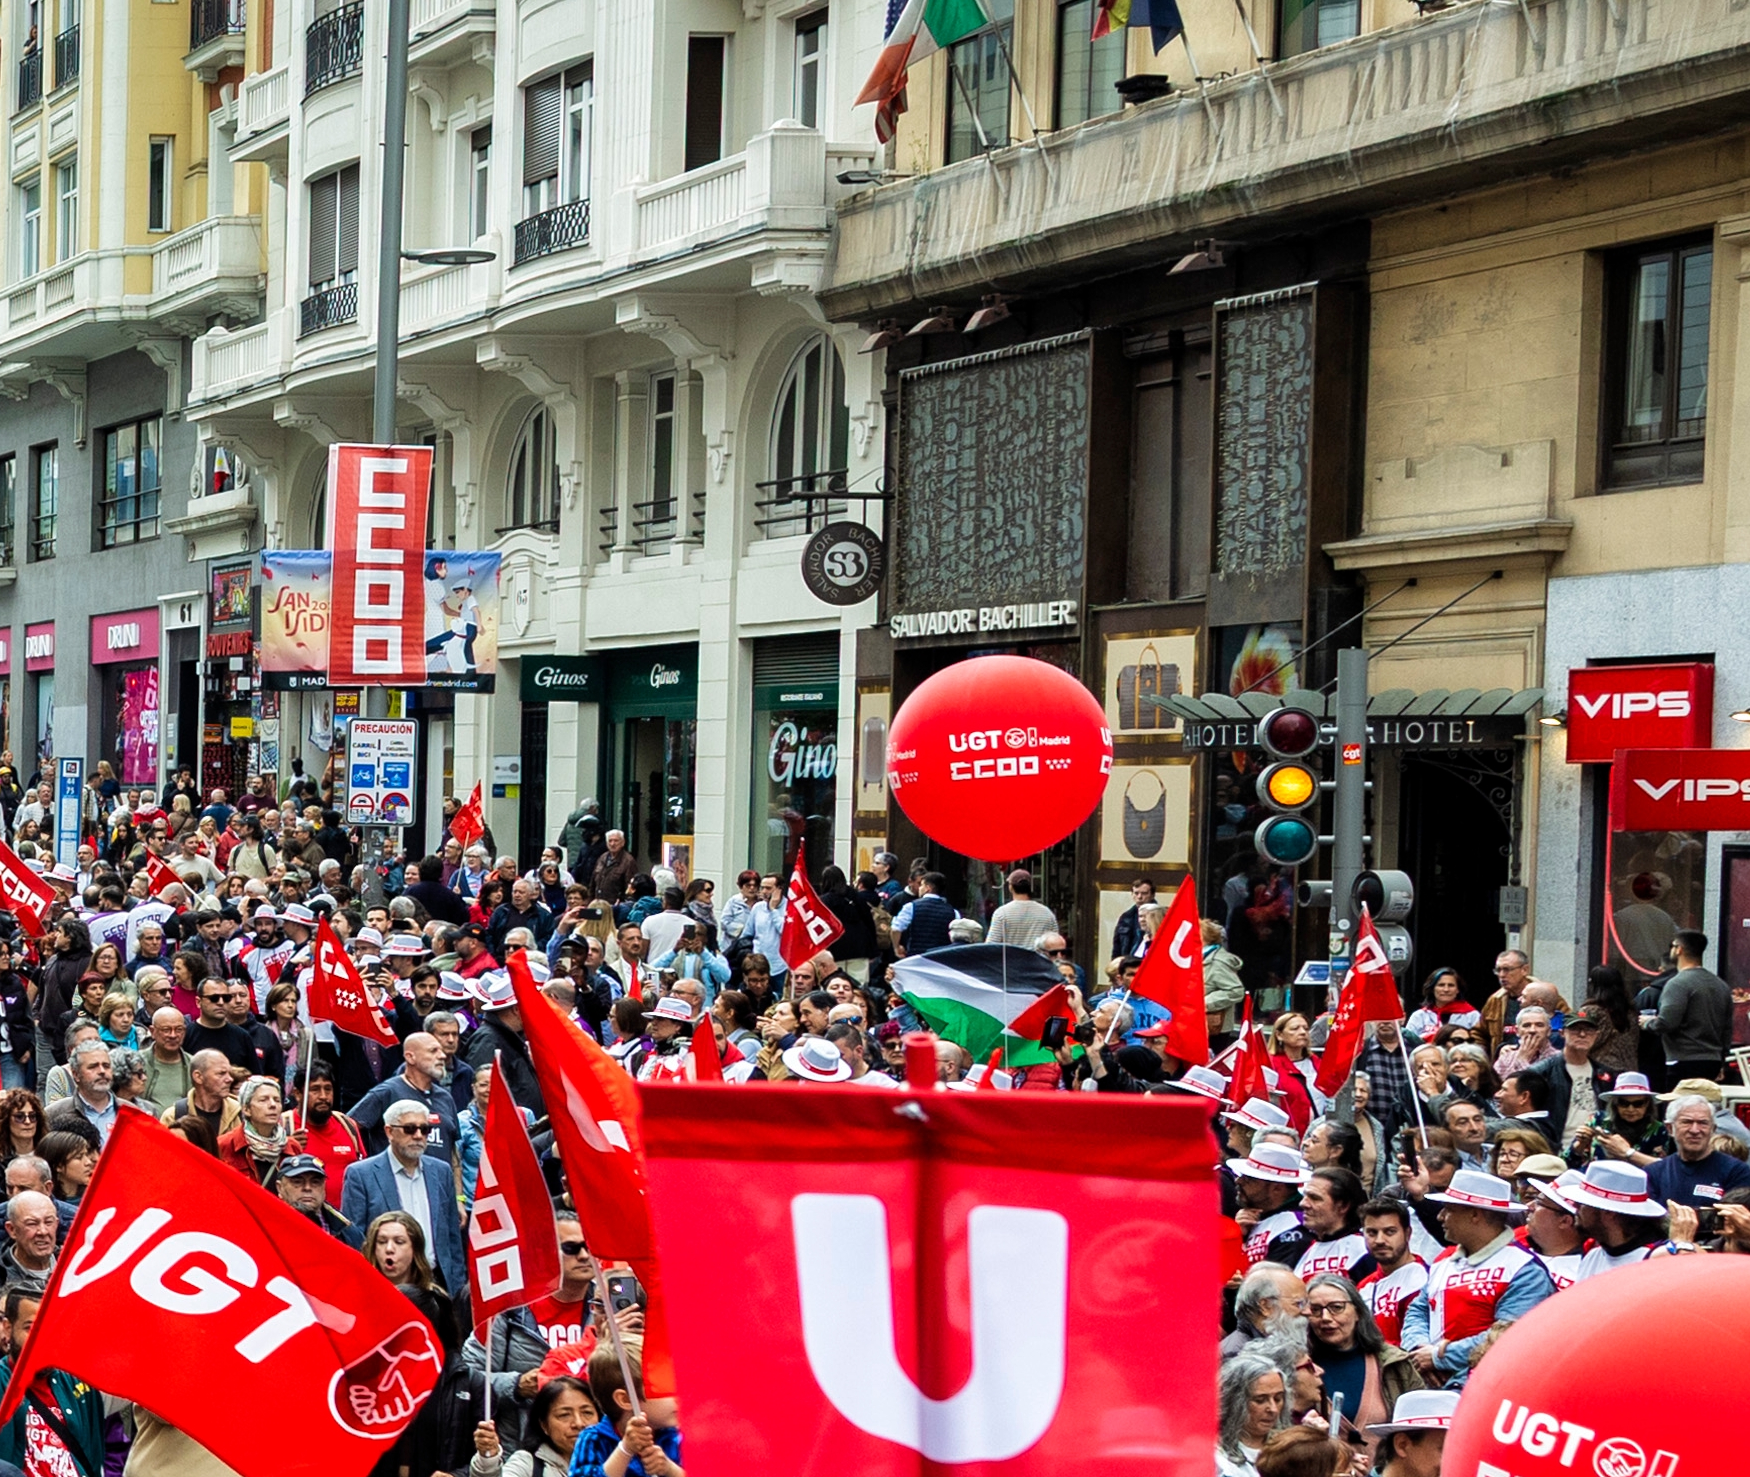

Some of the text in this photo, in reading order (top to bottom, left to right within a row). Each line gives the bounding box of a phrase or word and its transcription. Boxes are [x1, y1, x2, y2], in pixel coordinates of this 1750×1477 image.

[354, 457, 408, 674] CCOO
[267, 586, 314, 613] SAN
[180, 603, 193, 622] 61
[285, 610, 329, 637] ISID
[890, 601, 1074, 638] SALVADOR BACHILLER
[25, 634, 53, 659] DRUNI
[107, 622, 140, 649] DRUNI
[302, 676, 326, 686] MAD
[534, 666, 588, 688] Ginos
[650, 663, 680, 689] Ginos
[1574, 690, 1692, 719] VIPS
[355, 722, 413, 735] PRECAUCIÓN
[1382, 721, 1484, 743] HOTEL
[949, 730, 1071, 753] UGT Madrid
[1343, 747, 1361, 760] cgt
[768, 721, 837, 788] Gino
[949, 756, 1040, 781] CCOO
[1634, 779, 1750, 801] VIP
[57, 1205, 357, 1365] UGT
[1446, 1266, 1505, 1286] CCOO
[1492, 1399, 1594, 1469] UGT
